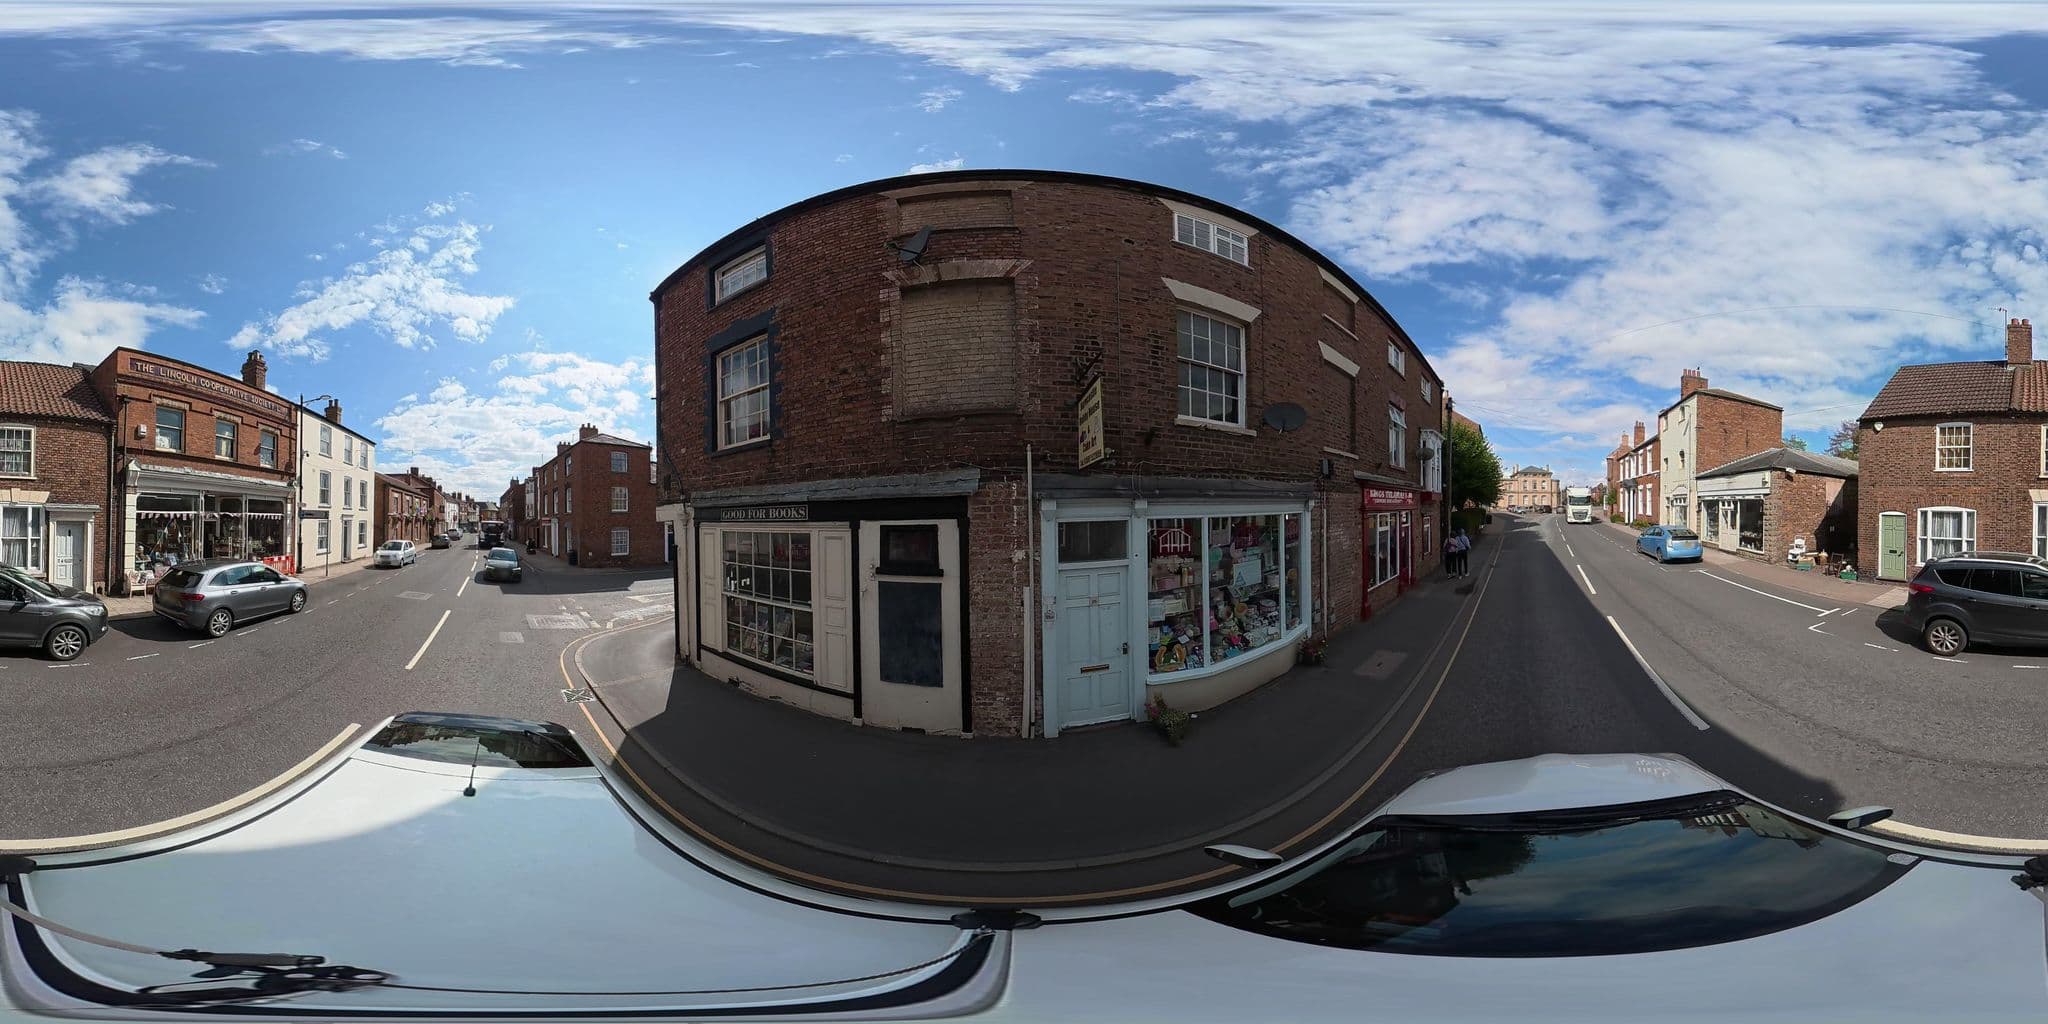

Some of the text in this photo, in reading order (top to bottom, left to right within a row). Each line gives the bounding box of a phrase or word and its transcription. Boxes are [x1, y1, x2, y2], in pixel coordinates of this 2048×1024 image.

[135, 361, 155, 374] THE
[160, 367, 198, 385] LINCOLN
[722, 506, 806, 519] GOOD FOR BOOKS
